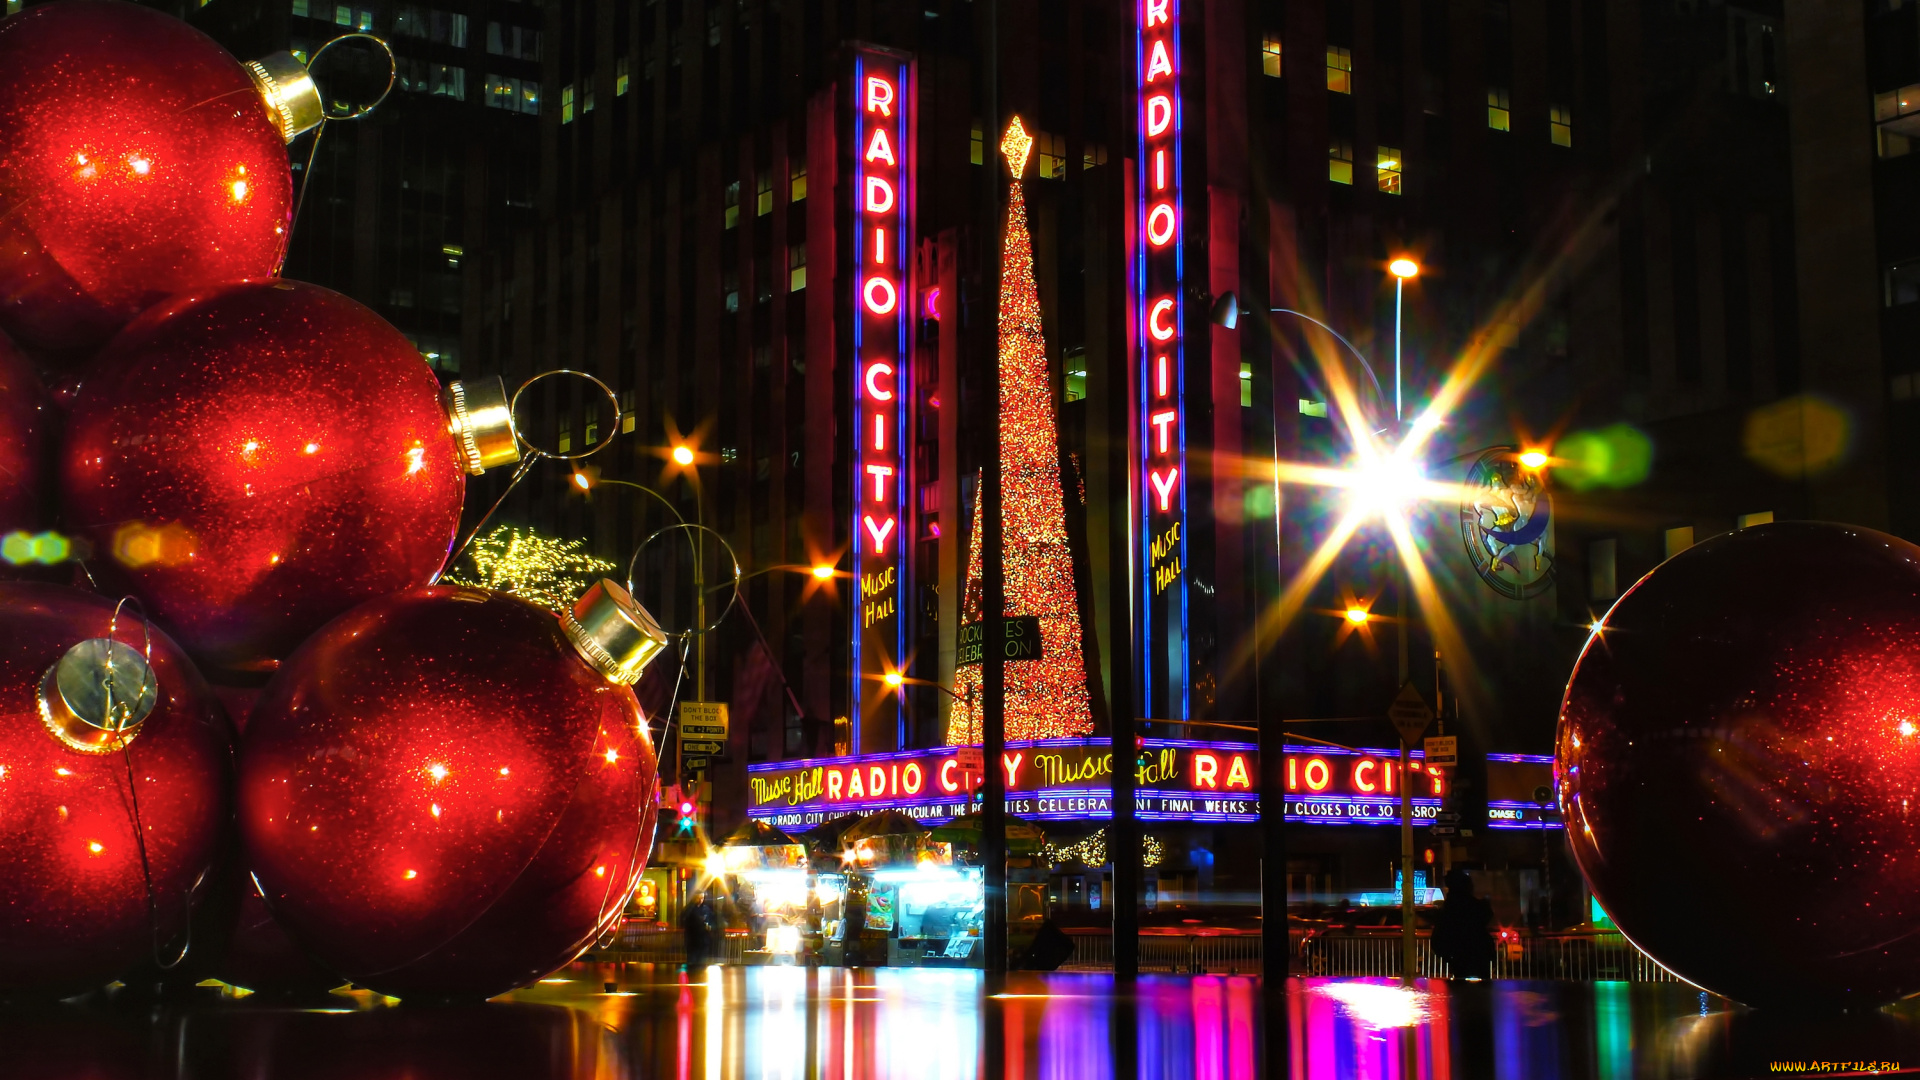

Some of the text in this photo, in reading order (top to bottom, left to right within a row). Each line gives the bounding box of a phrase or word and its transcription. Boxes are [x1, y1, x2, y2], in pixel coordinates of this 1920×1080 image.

[1147, 0, 1178, 510] RADIO CITY
[864, 77, 896, 553] RADIO CITY
[705, 744, 718, 752] WAY
[751, 753, 1022, 806] Music Hall RADIO CIY
[1195, 754, 1329, 791] RAIO
[777, 813, 802, 825] RADIO
[805, 812, 824, 824] CITY
[950, 803, 966, 816] THE
[1161, 799, 1196, 813] FINAL
[1295, 802, 1342, 816] CLOSES
[1348, 804, 1371, 816] DEC
[1377, 804, 1394, 817] 30
[1489, 810, 1515, 818] CHASE
